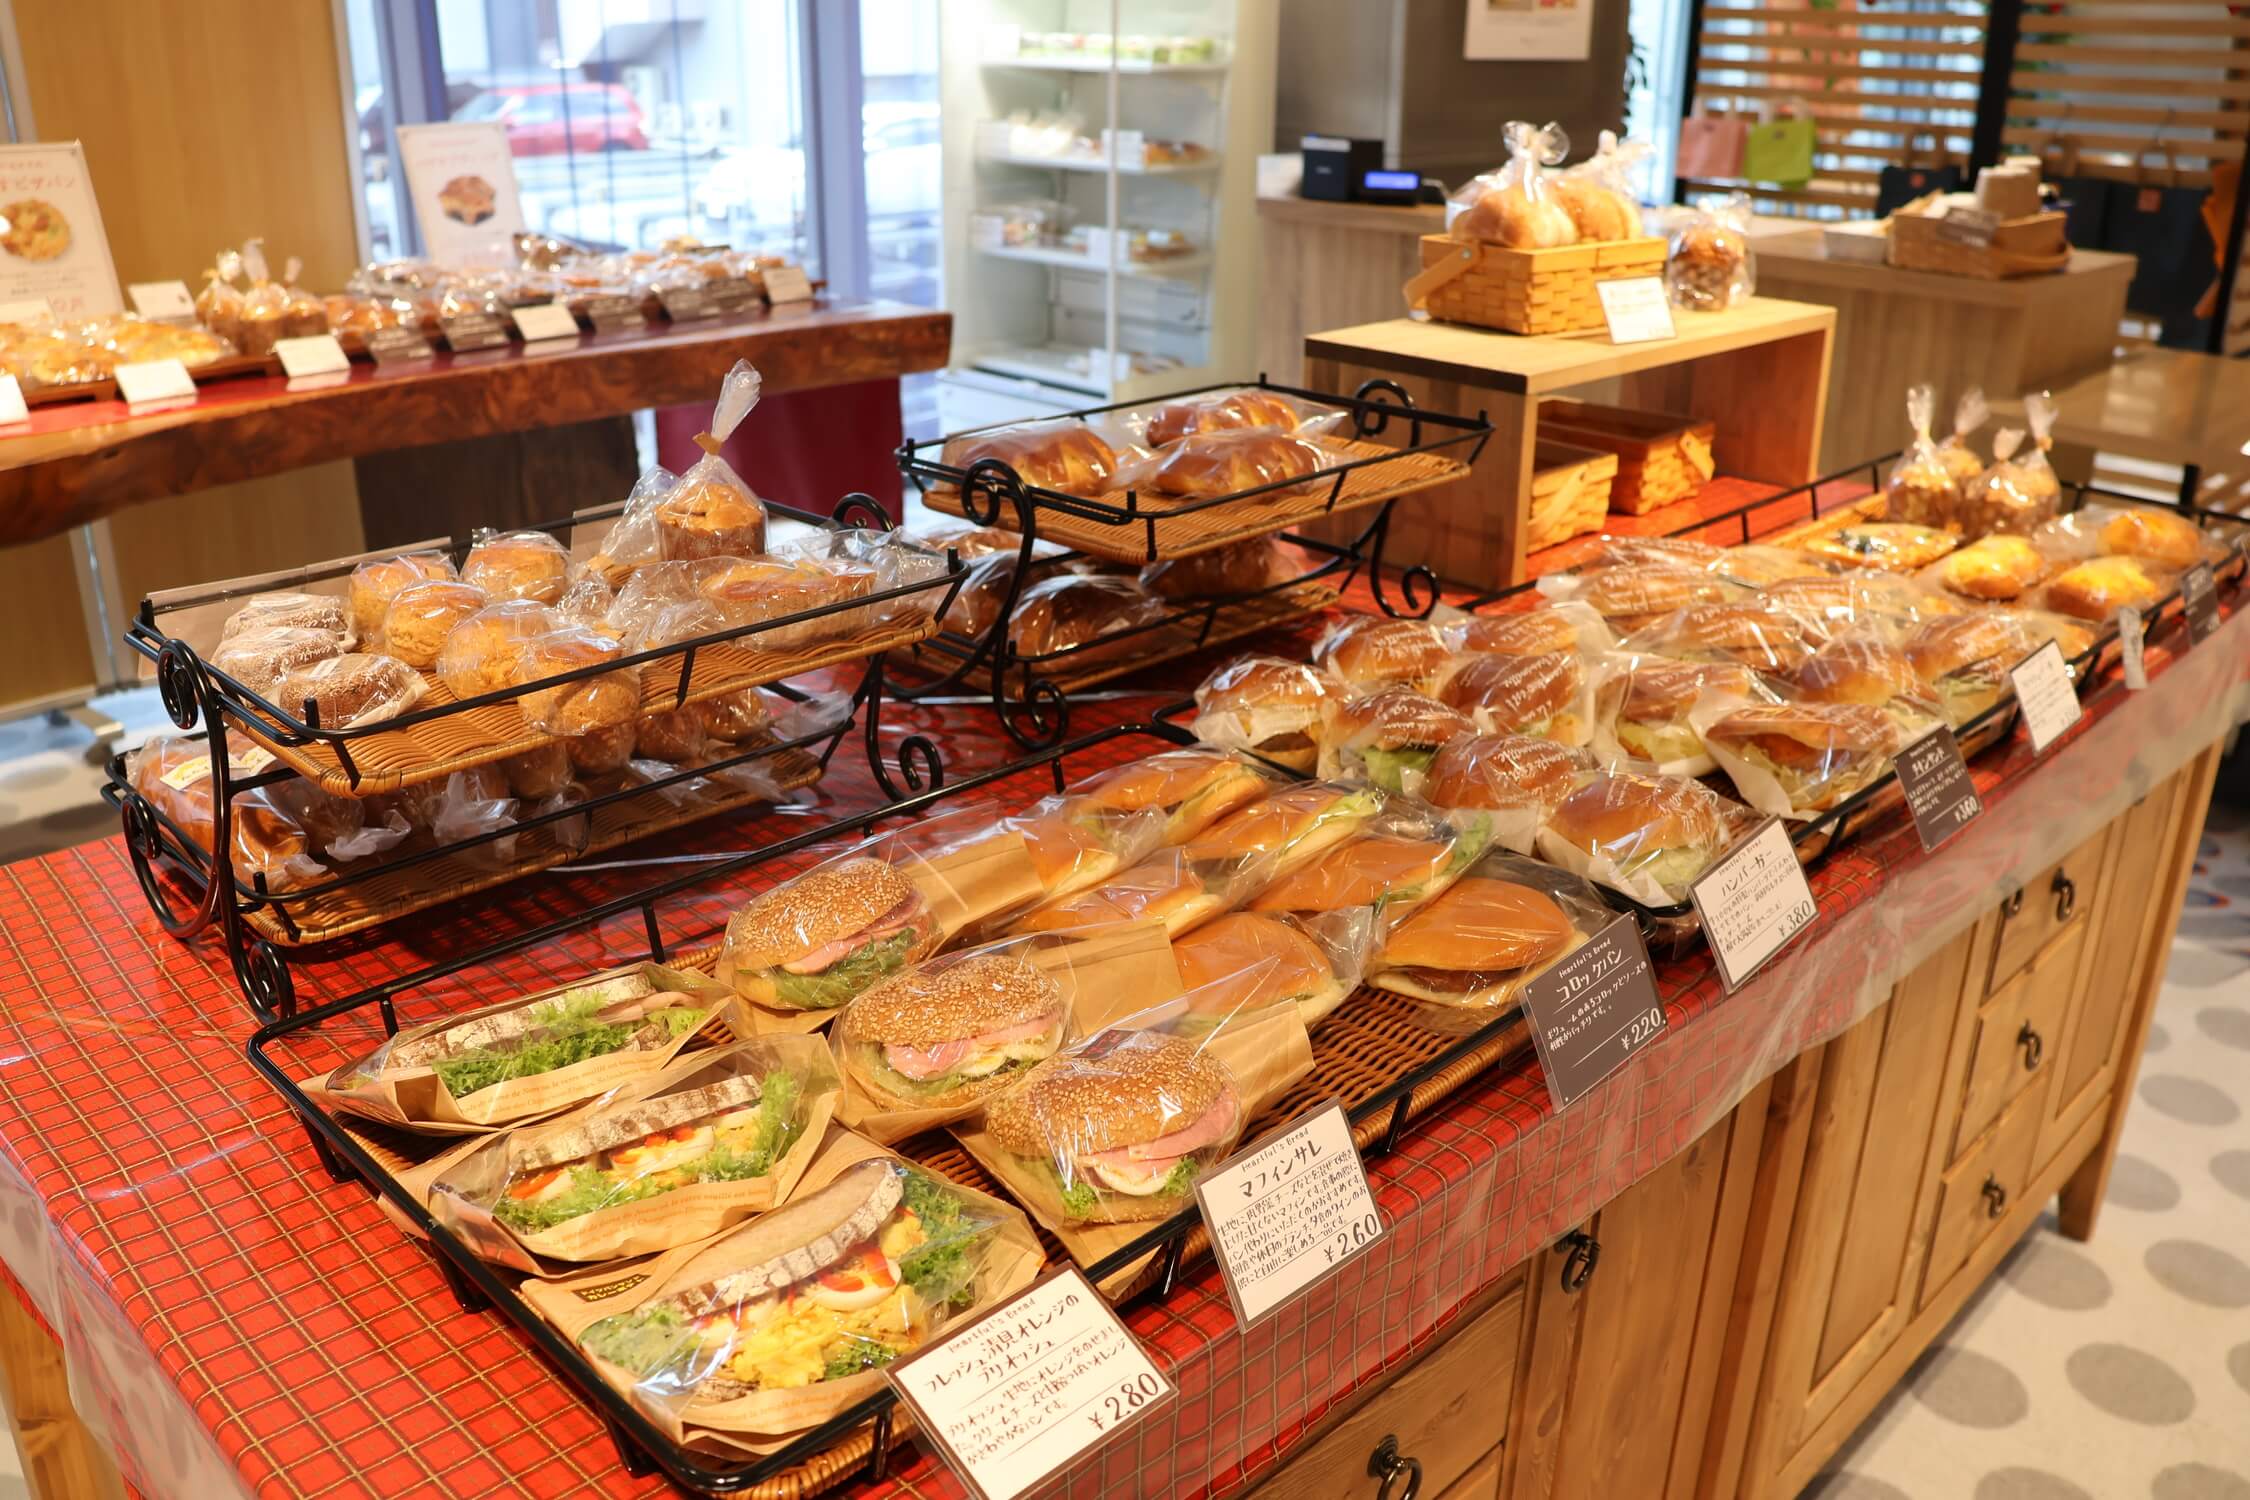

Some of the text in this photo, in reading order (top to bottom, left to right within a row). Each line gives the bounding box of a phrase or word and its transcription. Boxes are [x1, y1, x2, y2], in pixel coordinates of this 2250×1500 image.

[1721, 850, 1773, 897] ハンバーガー
[1593, 937, 1611, 955] Bread
[1556, 948, 1622, 1003] コロッケパン
[1239, 1139, 1322, 1198] マフィンサレ
[1241, 1128, 1309, 1172] Heartful's Bread
[1323, 1213, 1378, 1263] ¥260
[924, 1294, 1079, 1393] フレッシュ清見オレンジの
[948, 1298, 1035, 1354] Heartful's Bread
[976, 1339, 1056, 1385] ブリオッシュ
[1087, 1371, 1159, 1432] ¥280
